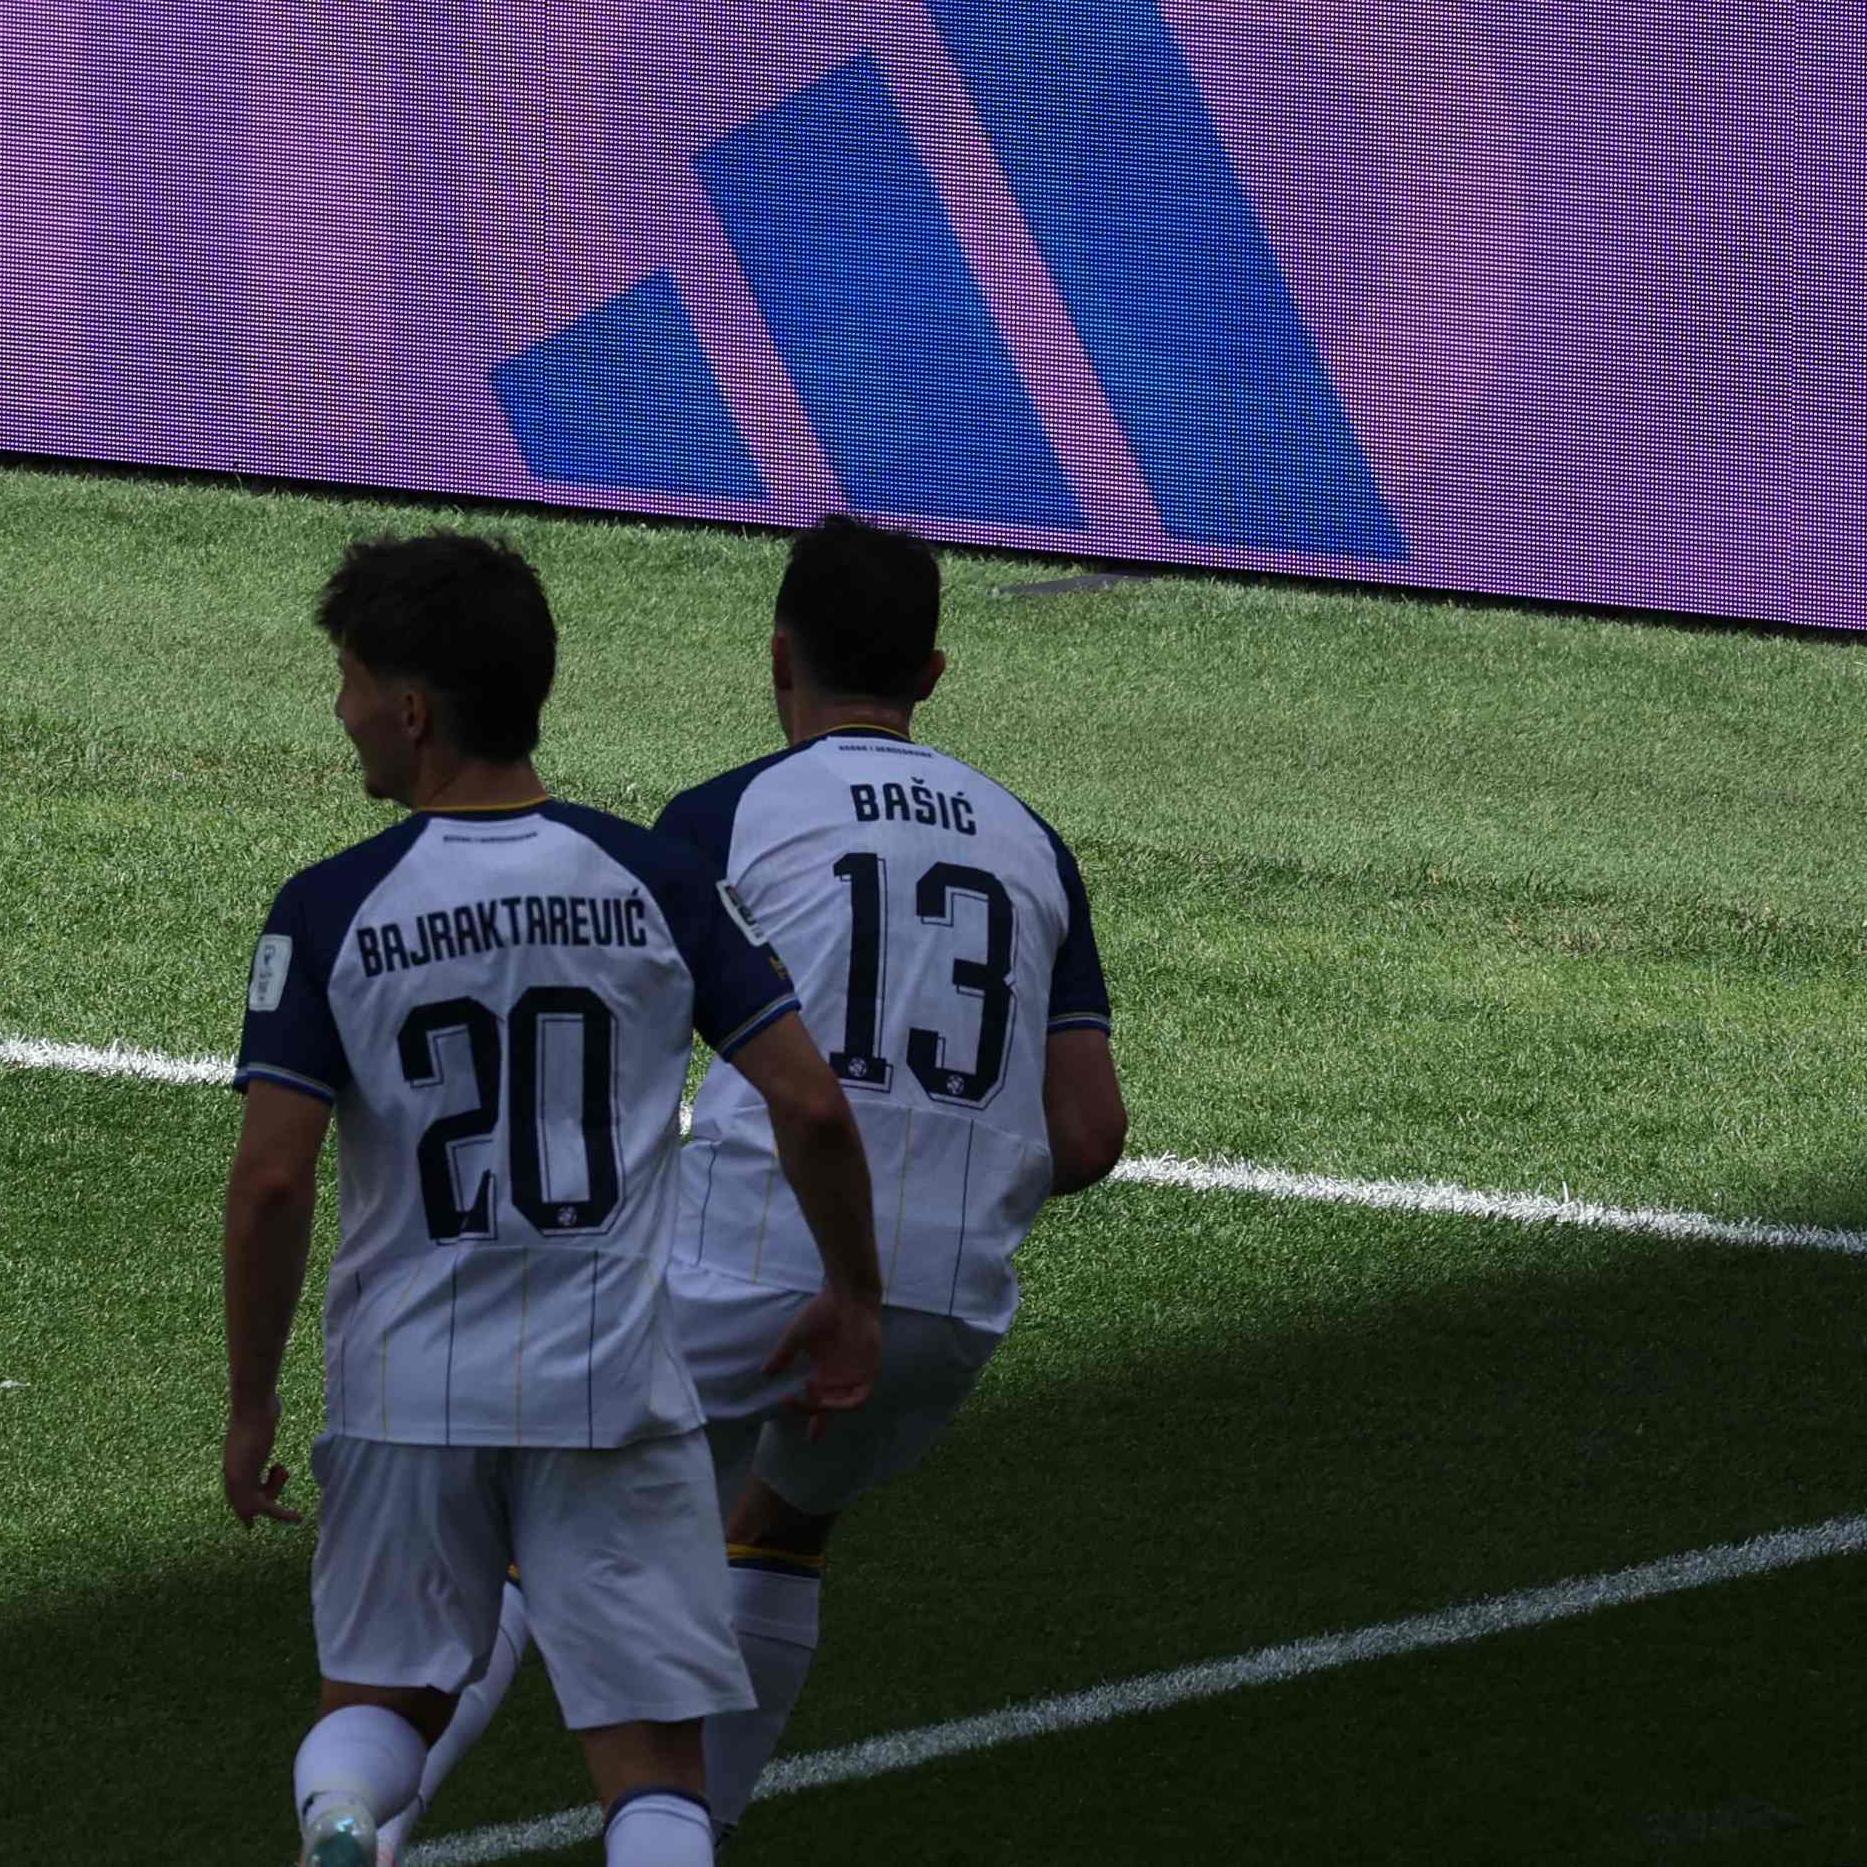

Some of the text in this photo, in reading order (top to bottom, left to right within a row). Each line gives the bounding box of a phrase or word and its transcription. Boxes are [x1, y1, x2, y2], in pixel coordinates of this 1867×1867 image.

[849, 776, 977, 836] BAŠIĆ
[356, 887, 648, 978] BAJRAKTAREVIĆ
[828, 852, 1019, 1110] 13
[396, 986, 626, 1246] 20
